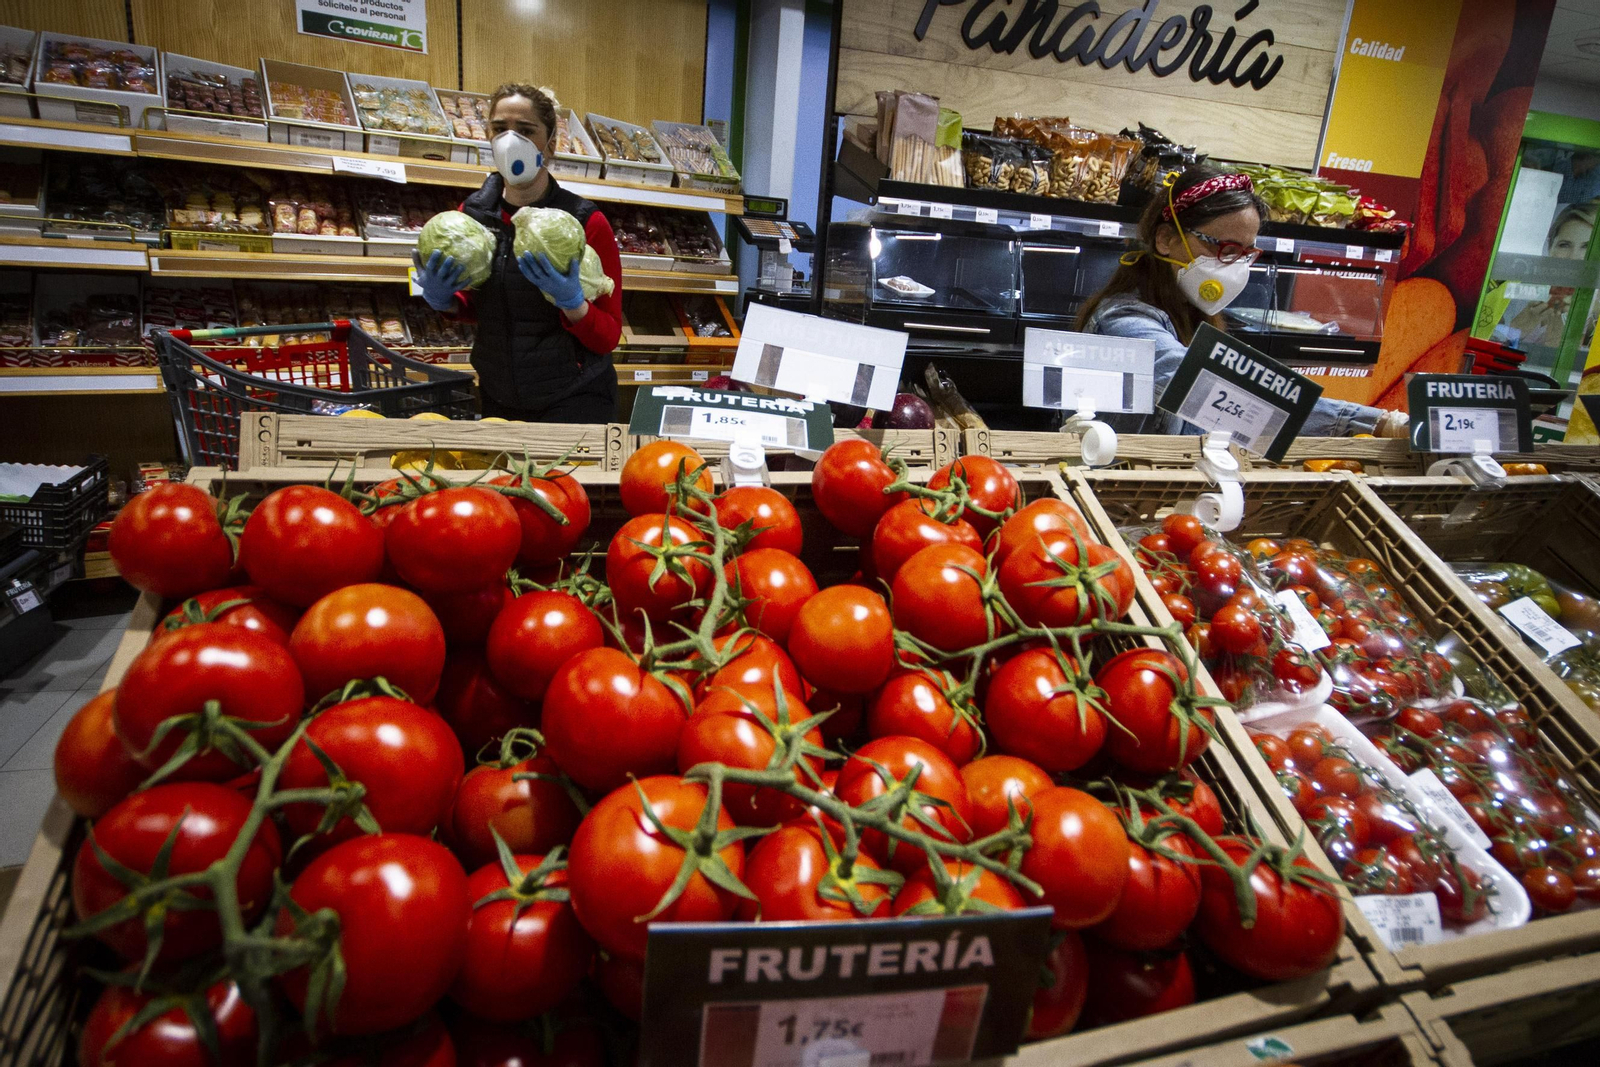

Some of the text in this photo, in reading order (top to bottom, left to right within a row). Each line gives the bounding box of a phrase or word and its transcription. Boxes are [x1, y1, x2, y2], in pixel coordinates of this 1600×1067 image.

[318, 0, 406, 21] solicítelo al personal
[1350, 37, 1406, 62] Calidad
[1325, 152, 1373, 173] Fresco
[1209, 341, 1302, 405] FRUTERÍA
[1427, 380, 1516, 400] FRUTERÍA
[1211, 390, 1245, 420] 2,25€
[702, 412, 747, 426] 1,85€
[1445, 414, 1475, 431] 2,19€
[708, 930, 996, 984] FRUTERÍA
[778, 1014, 864, 1045] 1,75€
